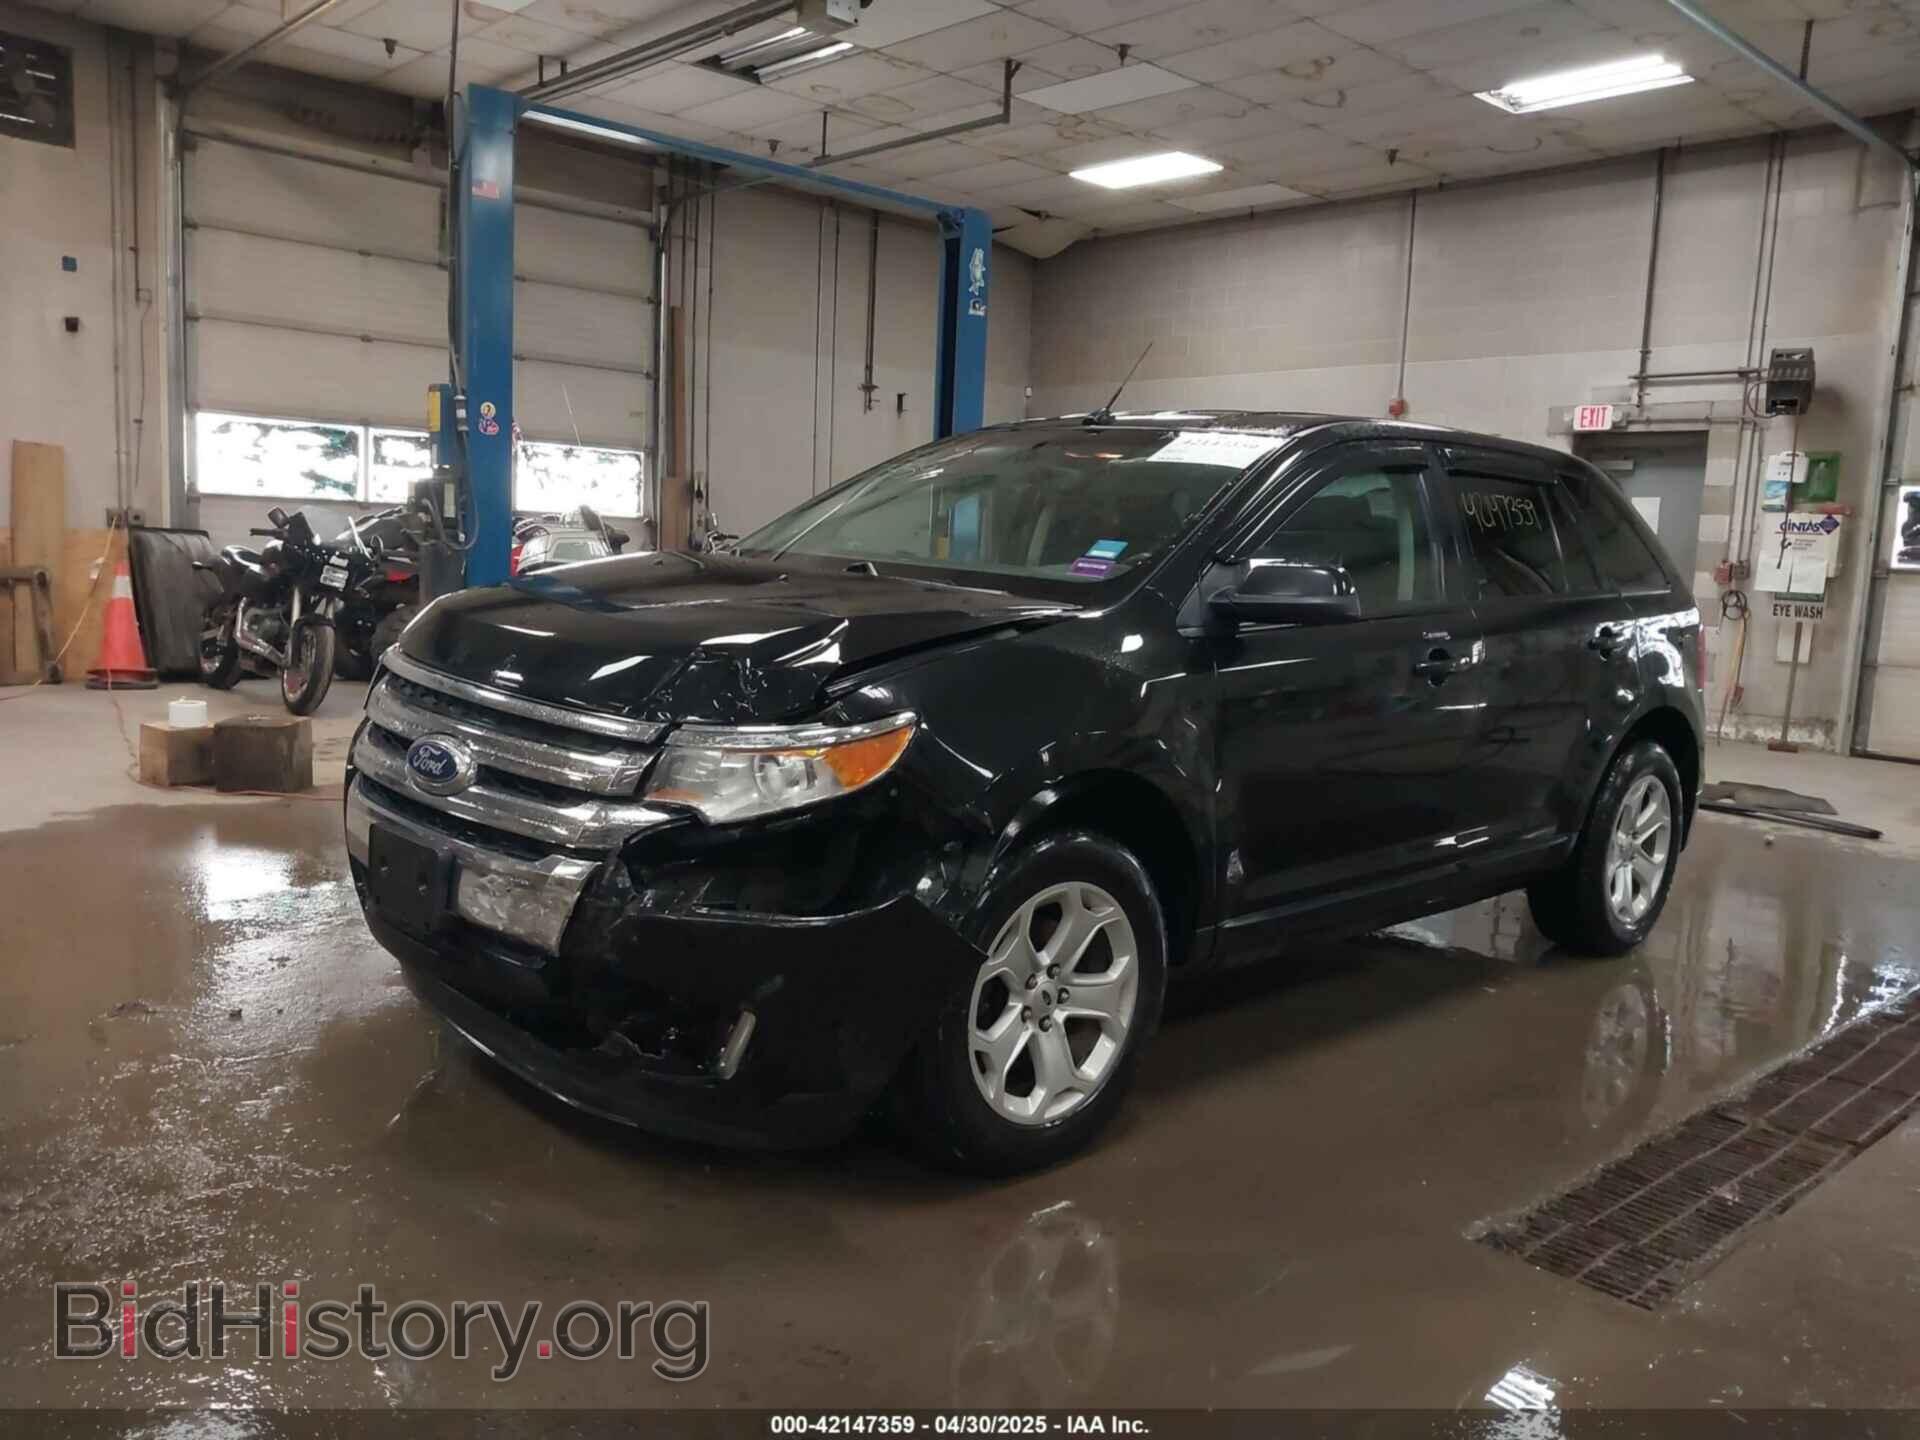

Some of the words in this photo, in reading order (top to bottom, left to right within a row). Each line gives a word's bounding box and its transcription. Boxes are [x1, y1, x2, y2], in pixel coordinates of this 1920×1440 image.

[1580, 407, 1608, 428] EXIT
[1772, 603, 1791, 617] EYE
[1794, 604, 1824, 619] WASH
[412, 744, 449, 775] Ford
